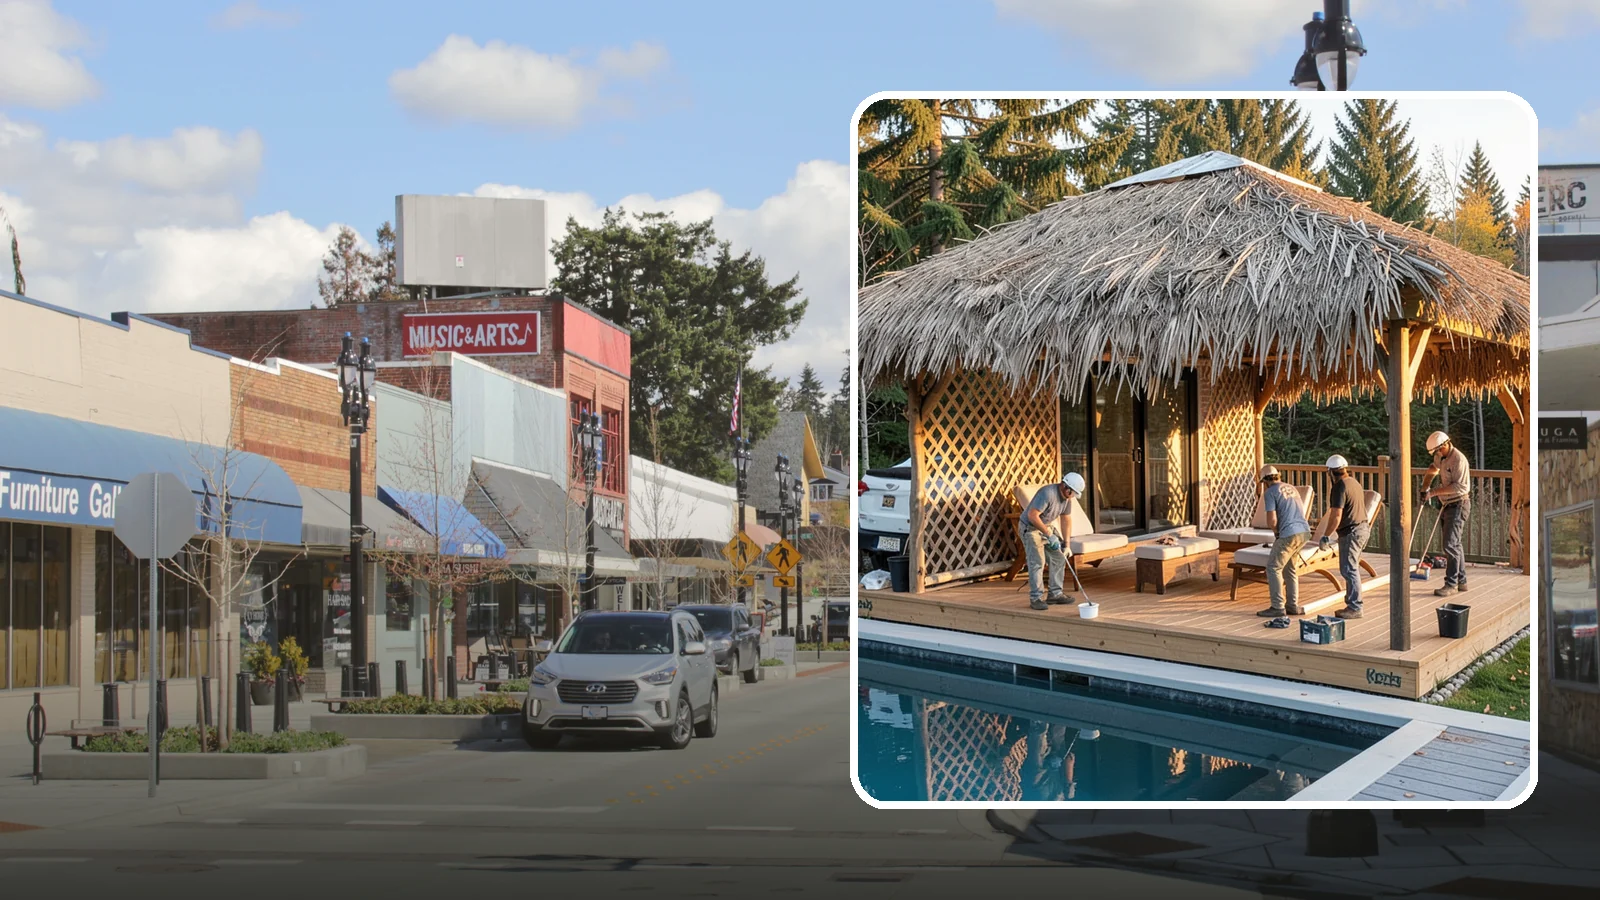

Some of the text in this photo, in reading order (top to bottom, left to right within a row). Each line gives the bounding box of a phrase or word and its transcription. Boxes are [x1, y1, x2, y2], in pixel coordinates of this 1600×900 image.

[409, 323, 519, 349] MUSIC&ARTS
[0, 471, 122, 519] Furniture Gal
[453, 563, 479, 574] SUSHI
